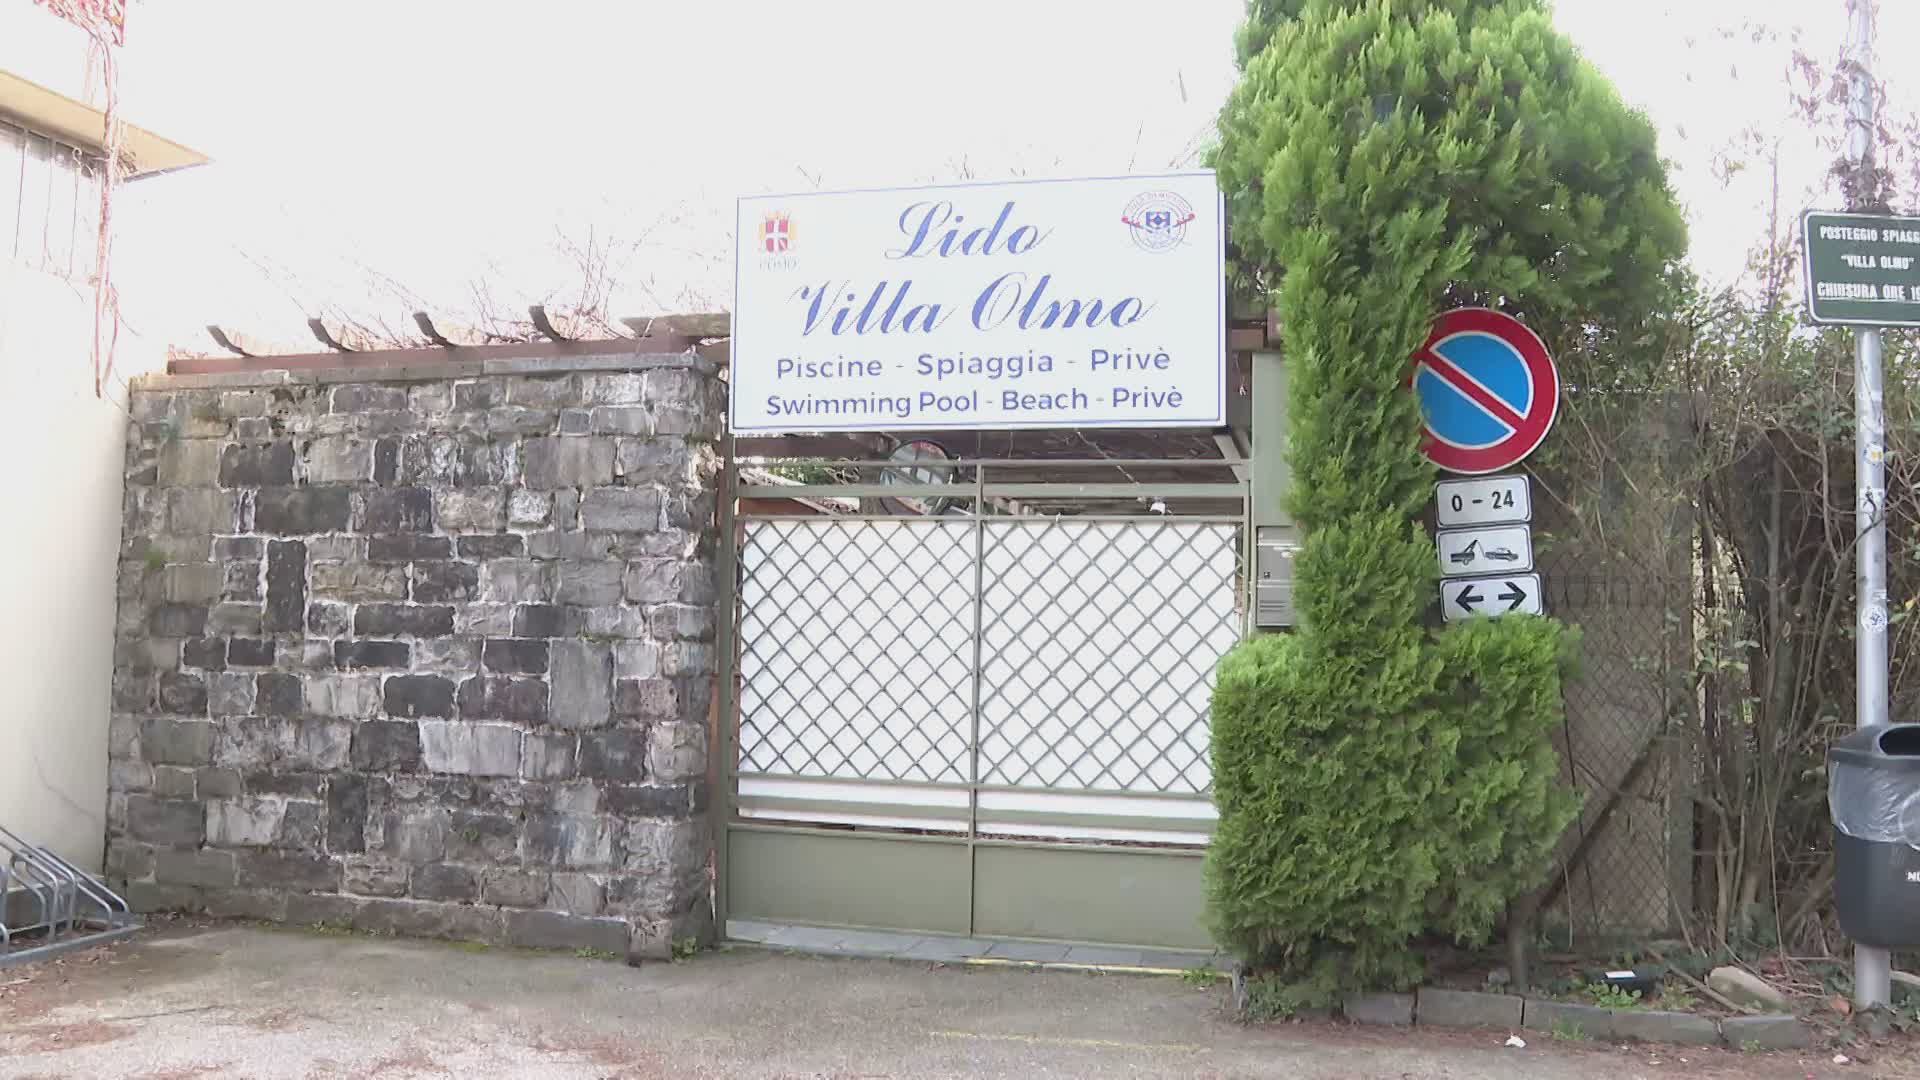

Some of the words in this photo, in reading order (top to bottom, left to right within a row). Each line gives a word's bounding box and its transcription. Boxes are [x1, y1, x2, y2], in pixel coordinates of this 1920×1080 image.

[884, 199, 1055, 260] Lido
[1820, 226, 1878, 241] POSTEGGIO
[785, 279, 958, 337] Villa
[971, 271, 1159, 332] Olmo
[1817, 282, 1878, 298] CHIUSURA
[1883, 284, 1905, 299] ORE
[777, 357, 882, 378] Piscine
[917, 350, 1054, 381] Spiaggia
[1091, 346, 1171, 371] Privè
[766, 391, 911, 417] Swimming
[919, 389, 978, 413] Pool
[1002, 387, 1088, 411] Beach
[1112, 385, 1183, 408] Privè
[1452, 495, 1462, 512] 0
[1492, 489, 1514, 510] 24
